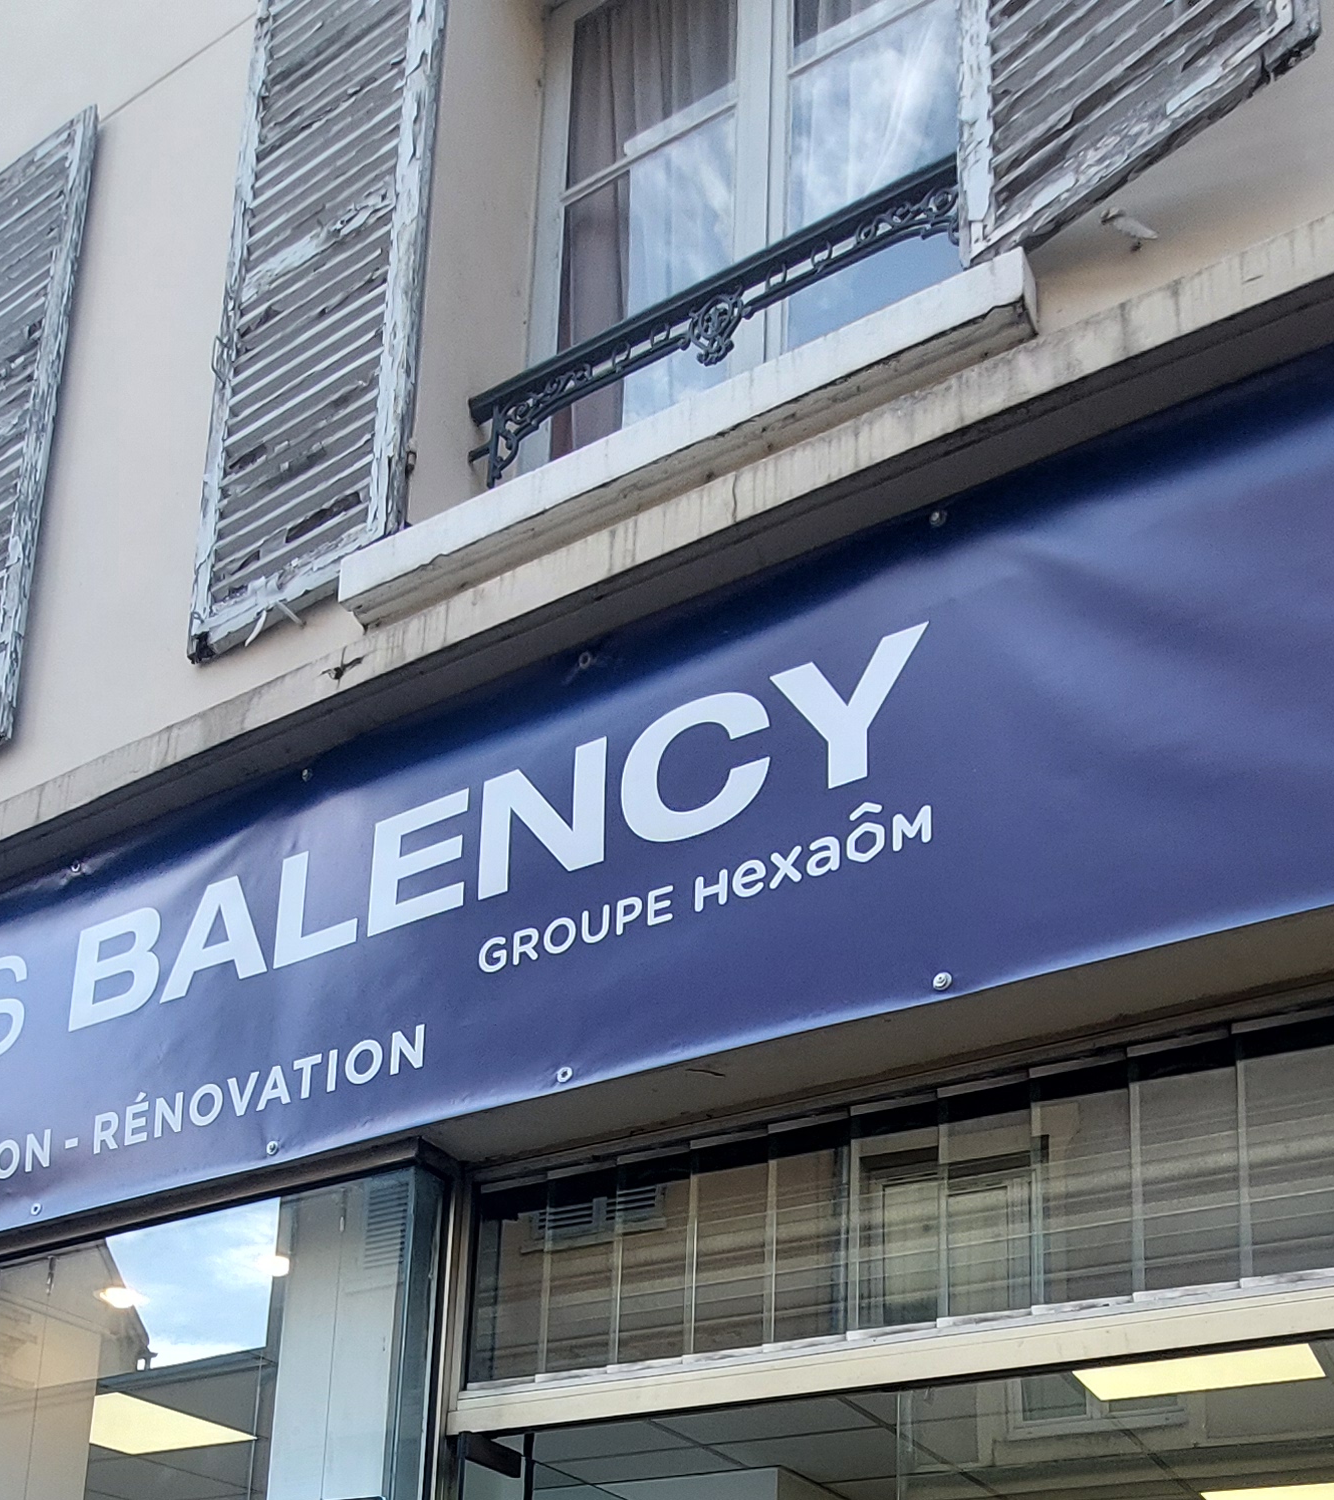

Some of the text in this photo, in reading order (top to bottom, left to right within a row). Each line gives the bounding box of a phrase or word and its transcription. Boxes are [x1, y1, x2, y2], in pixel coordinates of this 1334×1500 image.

[69, 622, 928, 1032] BALENCY
[478, 885, 675, 972] GROUPE
[93, 1024, 425, 1155] RÉNOVATION
